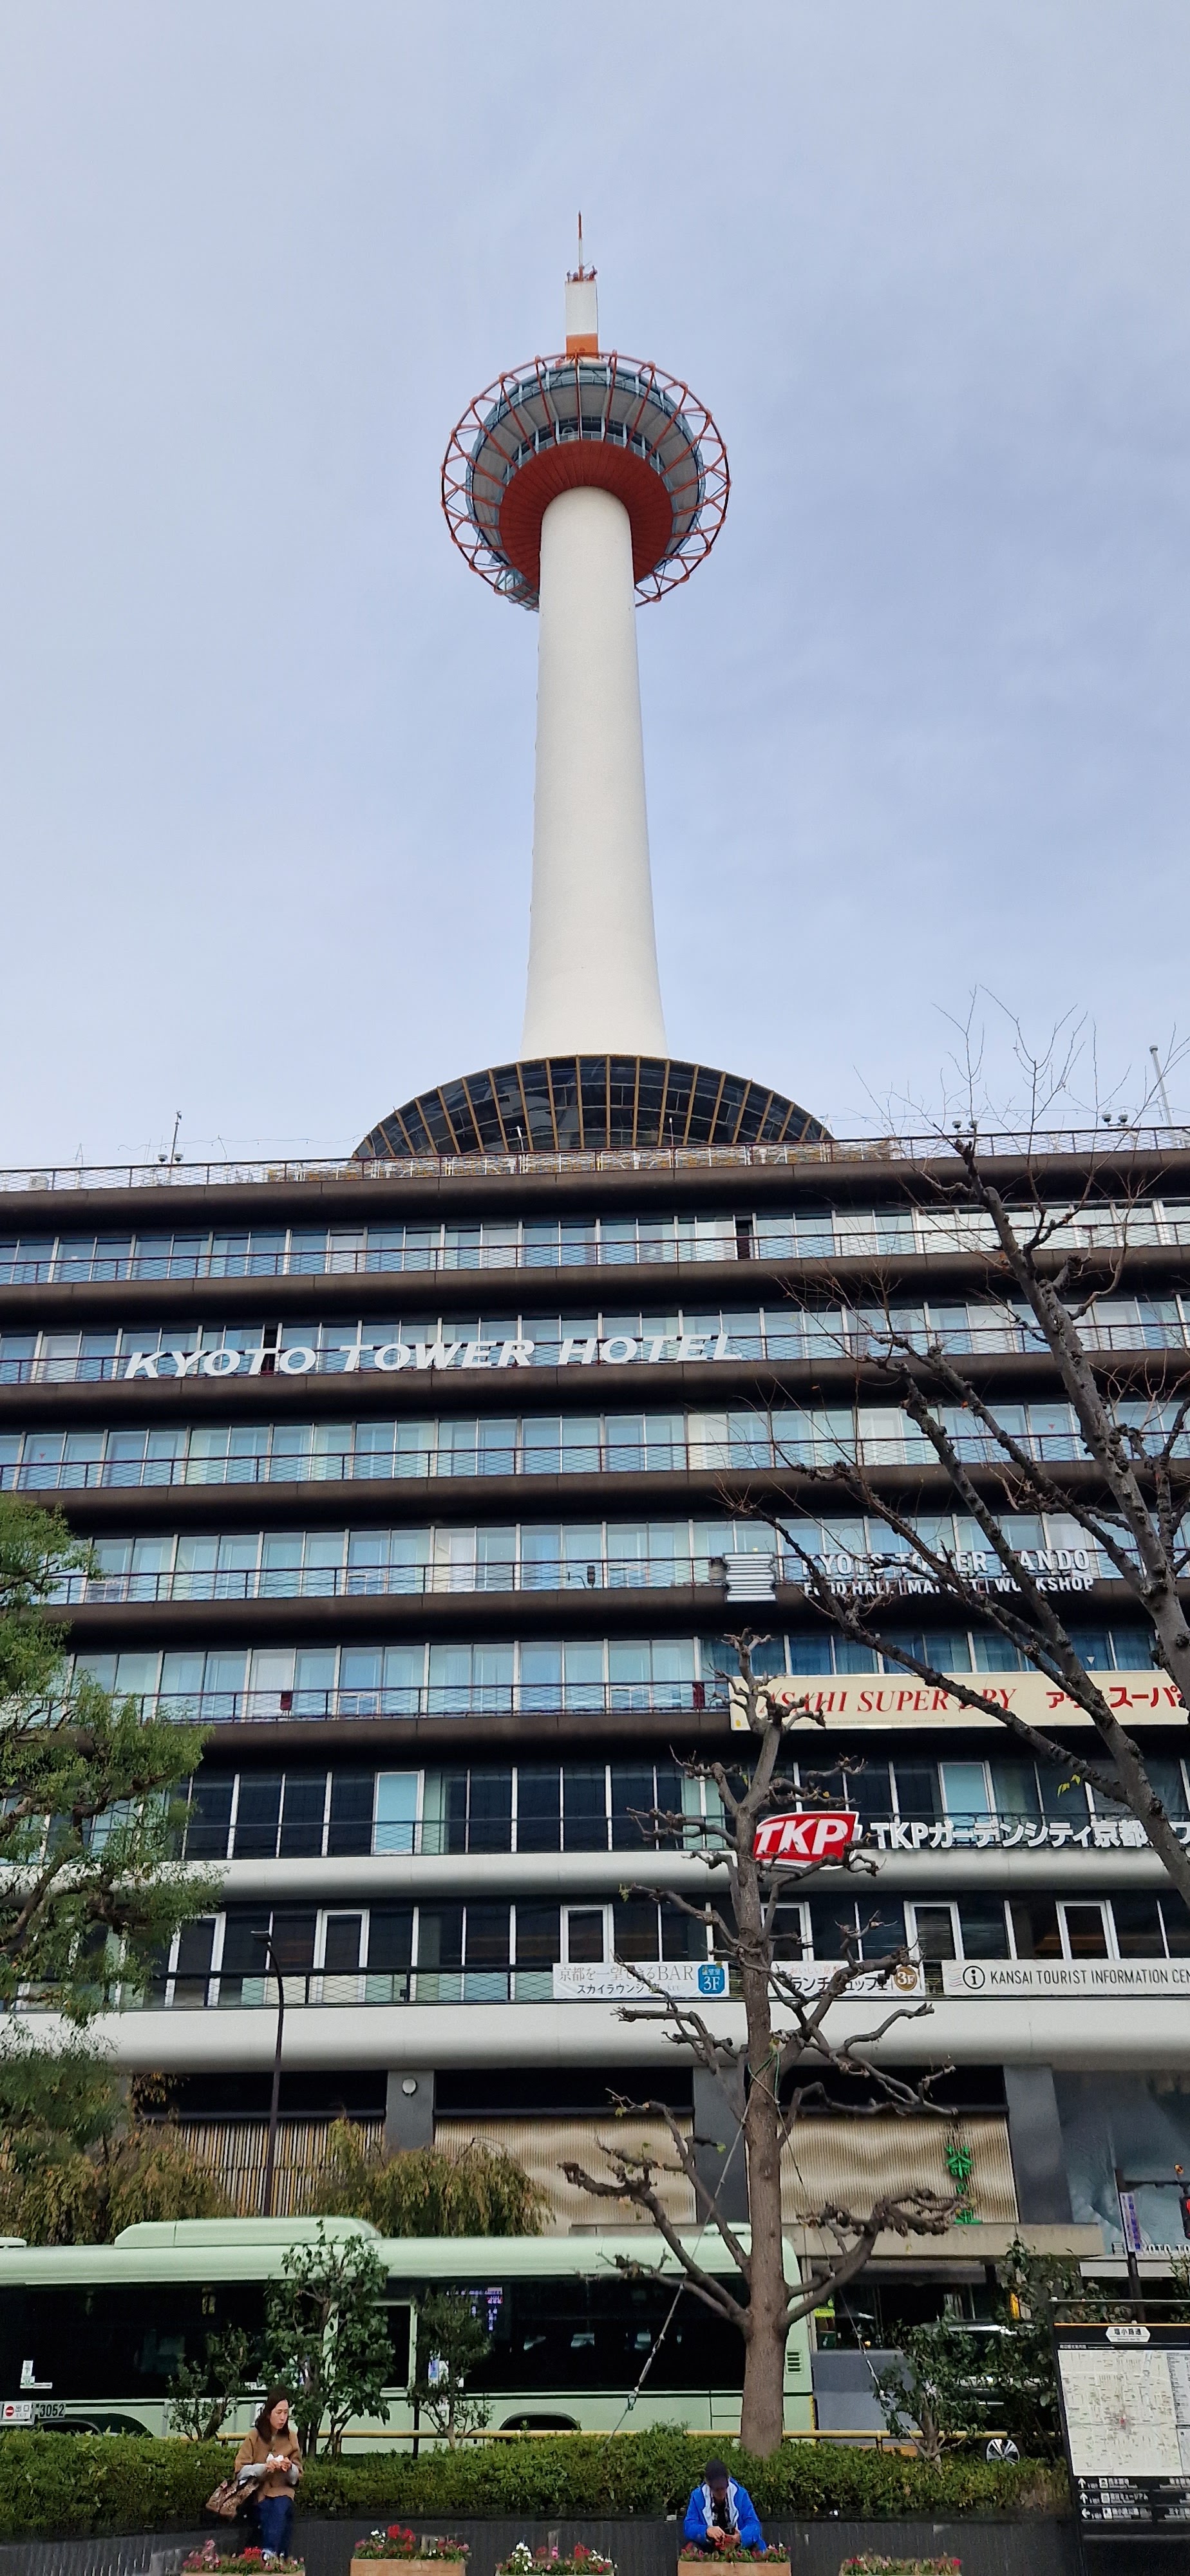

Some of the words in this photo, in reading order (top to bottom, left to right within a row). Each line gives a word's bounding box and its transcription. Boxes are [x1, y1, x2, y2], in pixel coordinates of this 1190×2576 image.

[124, 1348, 316, 1379] KYOTO
[340, 1340, 535, 1372] TOWER
[558, 1334, 742, 1365] HOTEL
[1002, 1549, 1090, 1571] ANDO
[995, 1577, 1094, 1593] WOKSHOP
[758, 1690, 849, 1714] SAHI
[857, 1690, 950, 1712] SUPER
[958, 1688, 1017, 1710] RY
[755, 1818, 849, 1855] TKP
[703, 1976, 721, 1991] 3F
[791, 1976, 888, 1991] ランチュッフェ
[897, 1971, 914, 1985] 3F
[990, 1970, 1033, 1985] KANSAI
[1037, 1969, 1088, 1984] TOURIST
[1091, 1969, 1169, 1984] INFORMATION
[577, 1984, 645, 1994] スカイラウンジ
[39, 2403, 64, 2417] 3052
